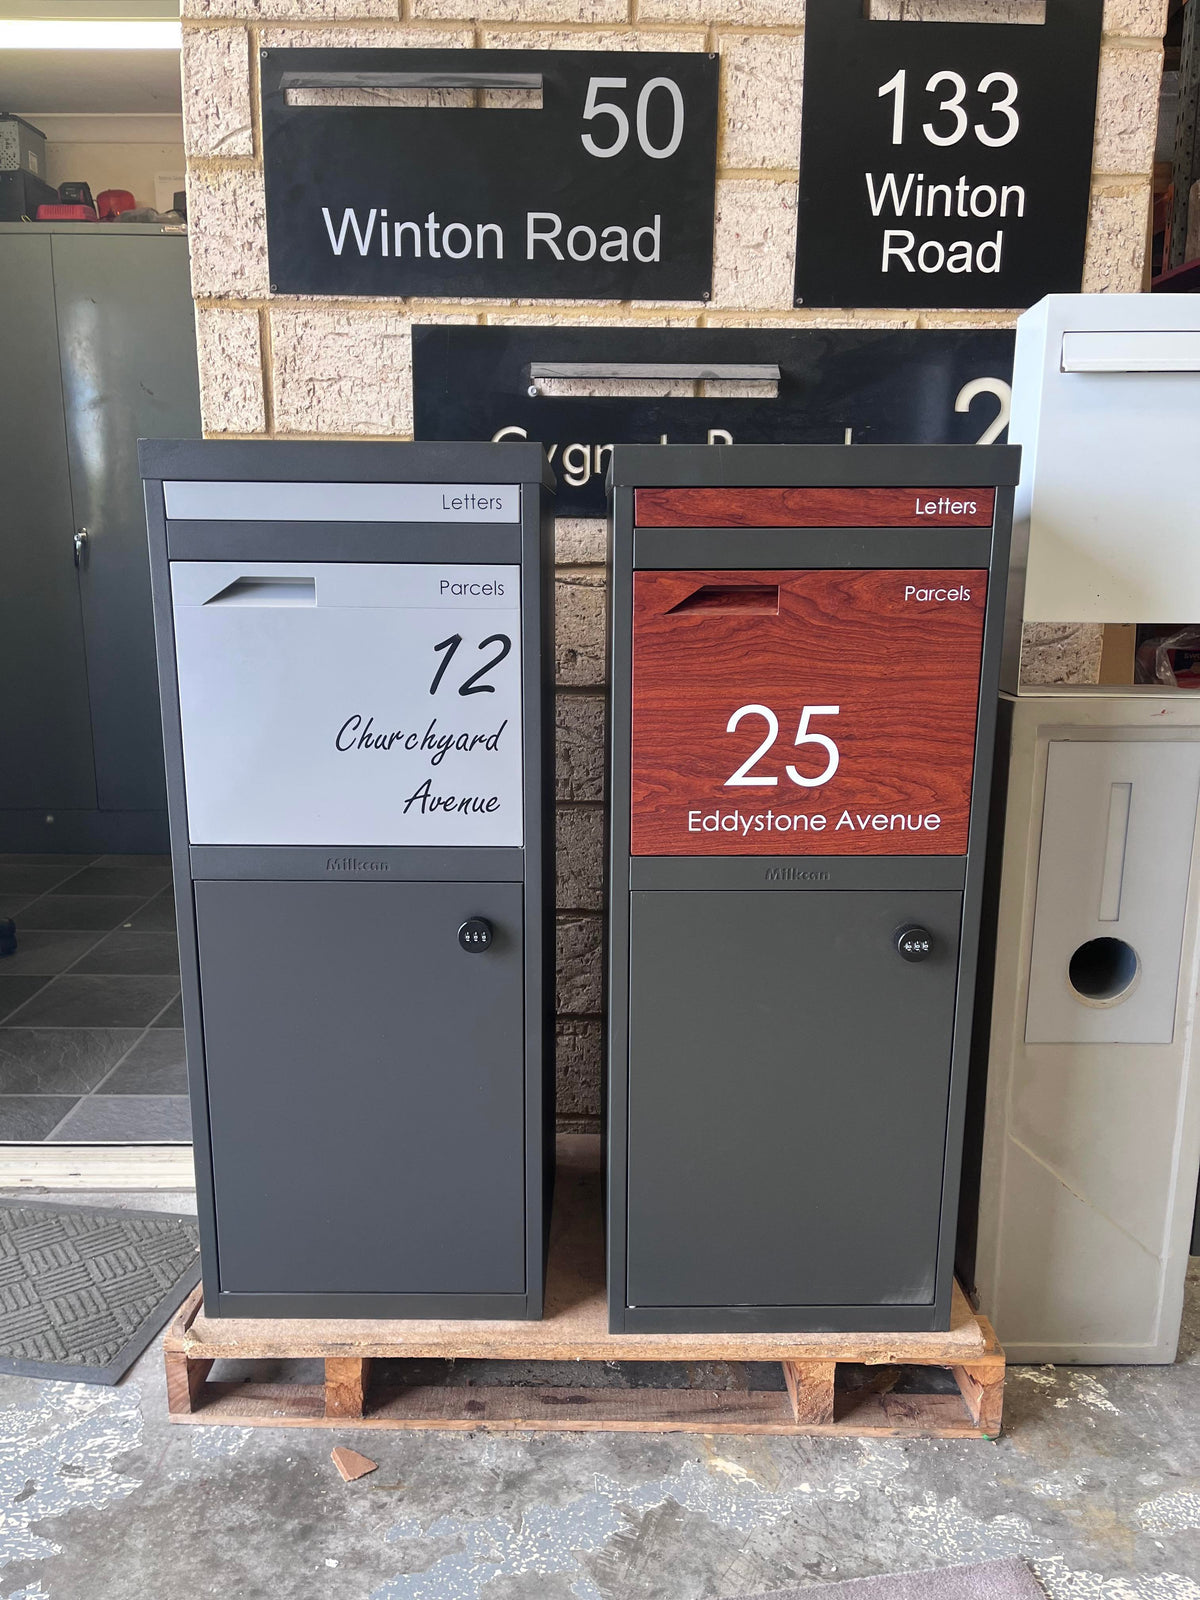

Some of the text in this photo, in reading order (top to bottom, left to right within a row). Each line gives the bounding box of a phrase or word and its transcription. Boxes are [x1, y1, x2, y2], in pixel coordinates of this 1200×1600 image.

[580, 76, 685, 159] 50
[878, 69, 1020, 148] 133
[865, 172, 1025, 218] Winton
[322, 207, 661, 263] Winton Road
[881, 229, 1003, 274] Road
[442, 493, 503, 511] Letters
[915, 497, 977, 515] Letters
[440, 579, 505, 596] Parcels
[904, 585, 971, 602] Parcels
[429, 633, 512, 697] 12
[335, 714, 508, 766] Churchyard
[723, 704, 840, 788] 25
[403, 778, 501, 815] Avenue
[688, 809, 941, 836] Eddystone Avenue
